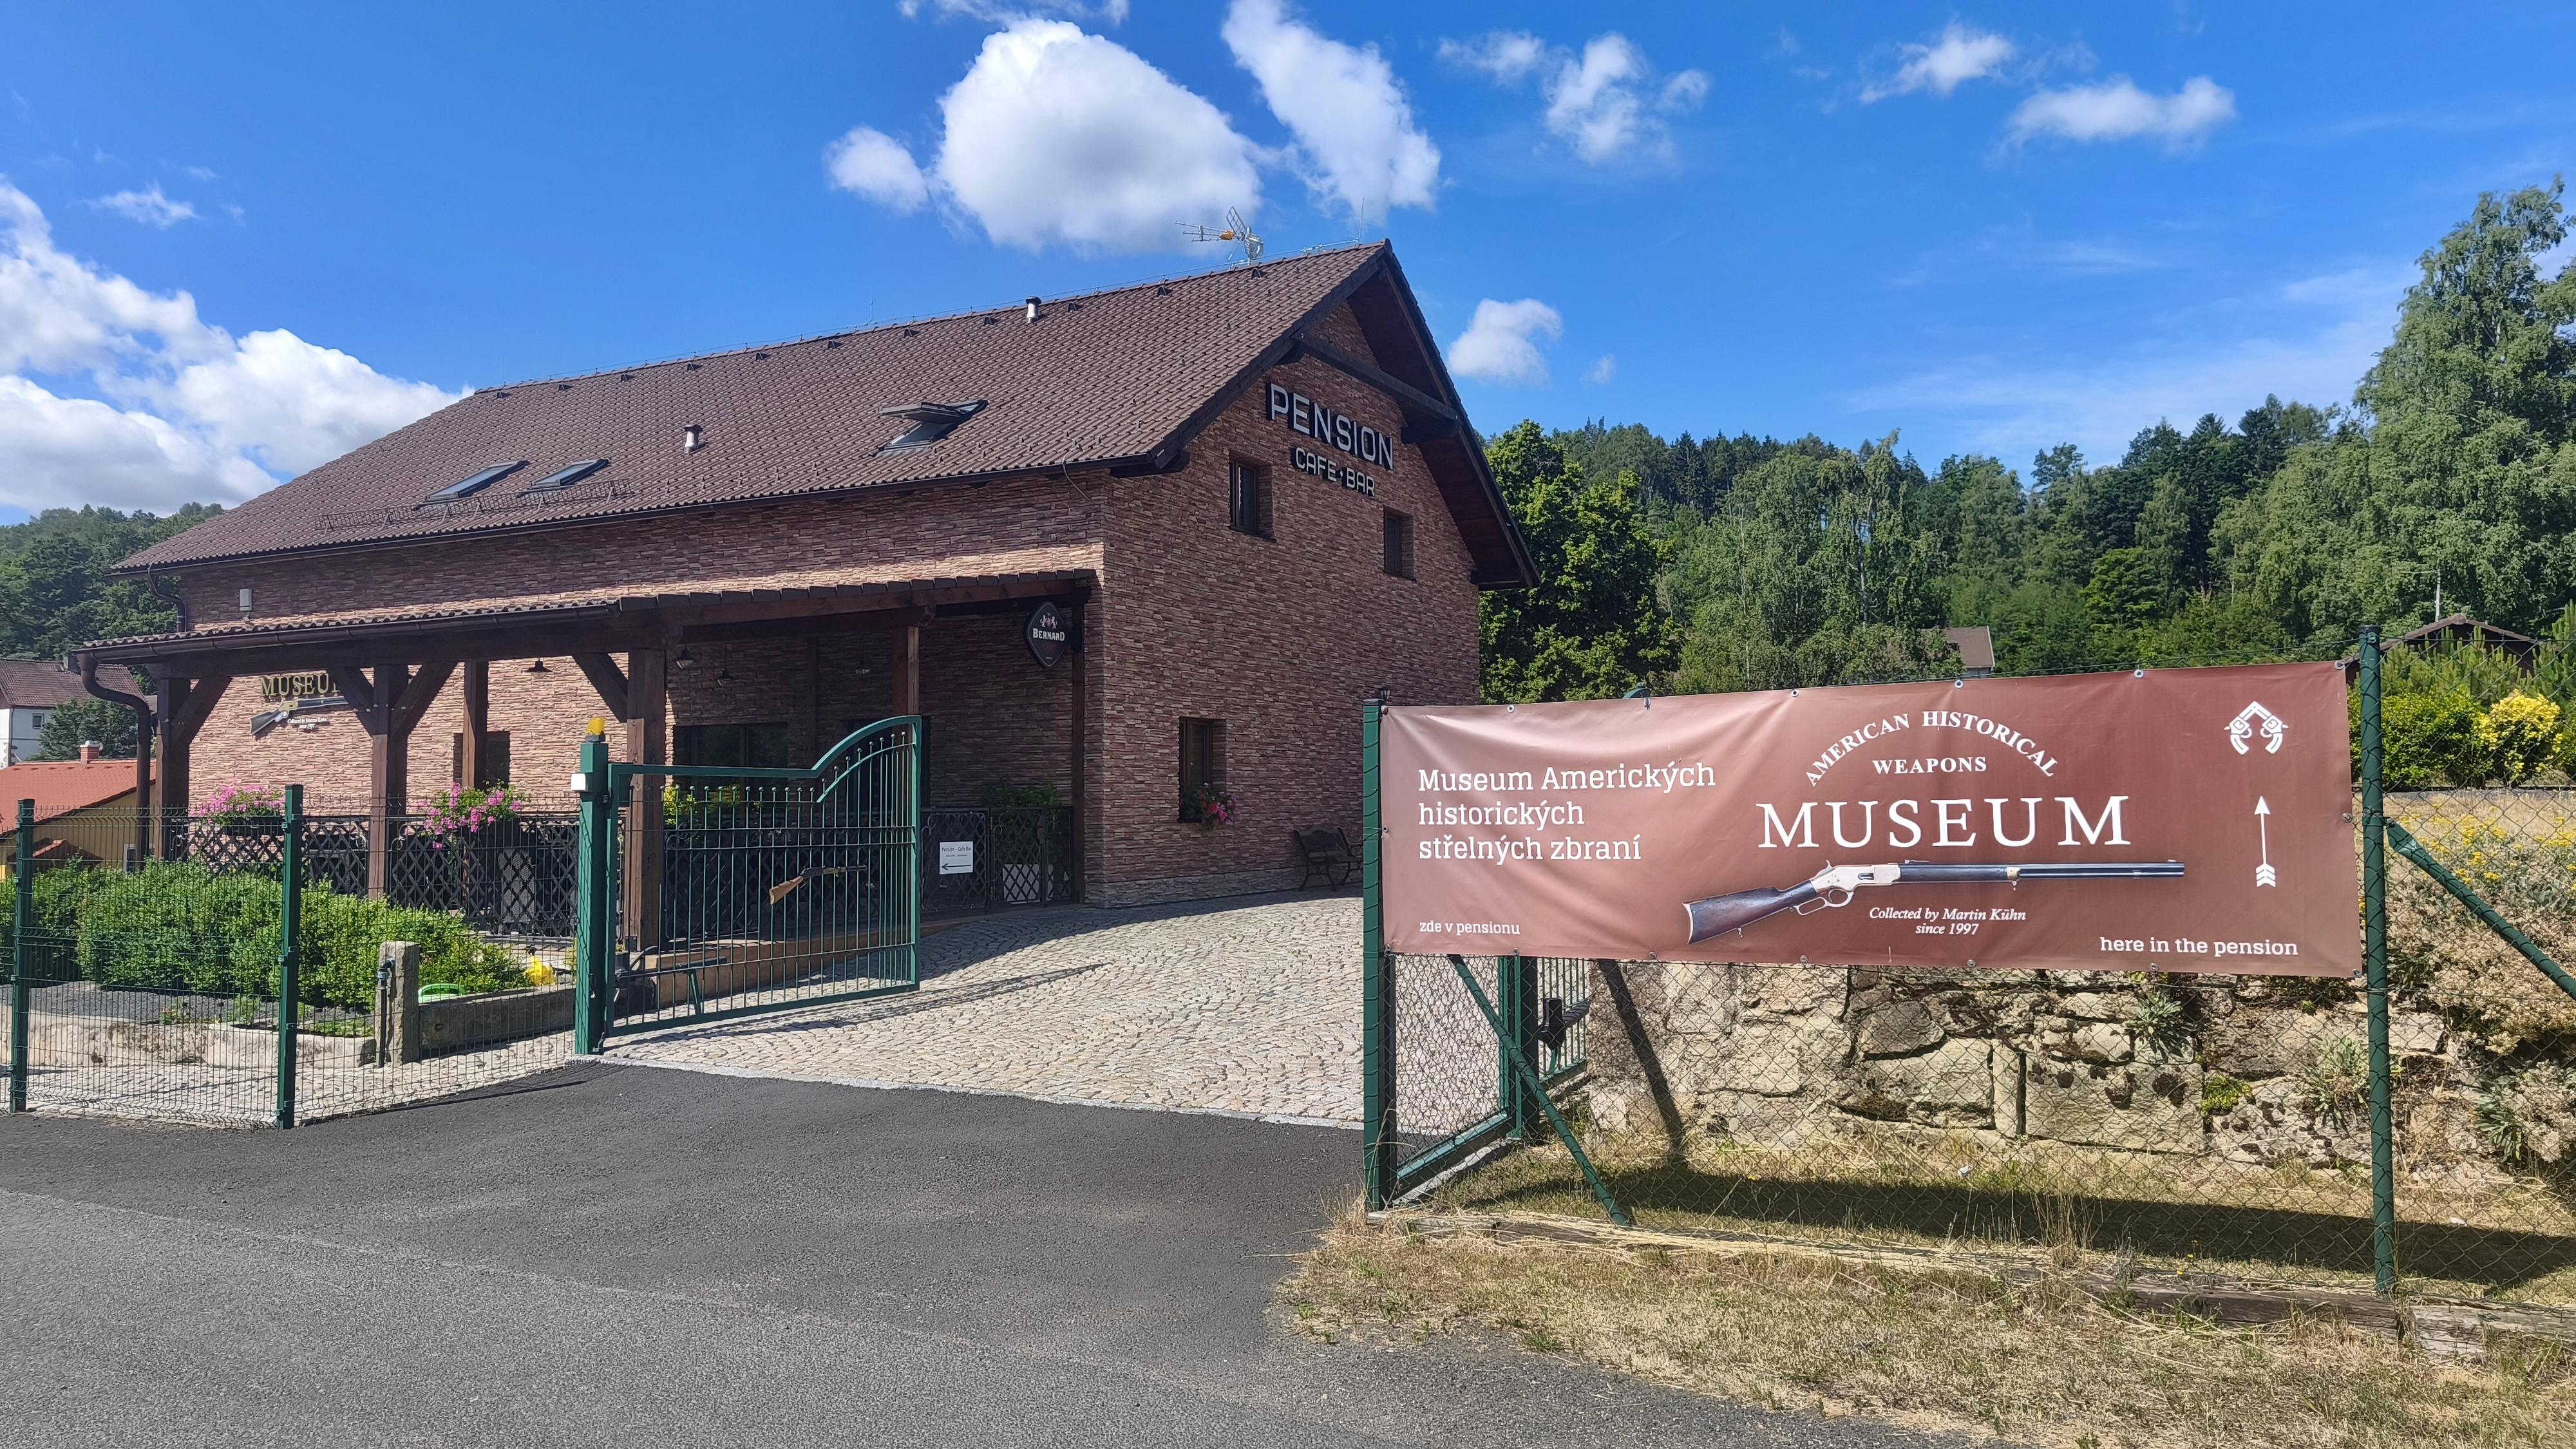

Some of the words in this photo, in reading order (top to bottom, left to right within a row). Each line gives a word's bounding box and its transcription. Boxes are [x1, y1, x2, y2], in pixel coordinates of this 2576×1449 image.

[1269, 383, 1393, 470] PENSION
[1032, 628, 1065, 641] BERNARD
[1806, 713, 1909, 788] AMERICAN
[1921, 710, 2059, 777] HISTORICAL
[1418, 769, 1534, 791] Museum
[1540, 761, 1716, 793] Amerických
[1871, 756, 1987, 775] WEAPONS
[1418, 800, 1585, 831] historických
[1755, 795, 2132, 848] MUSEUM
[1419, 834, 1543, 866] střelných
[1550, 833, 1642, 860] zbraní
[1419, 920, 1442, 933] zde
[1444, 922, 1454, 933] v
[1456, 922, 1520, 936] pensionu
[1869, 907, 1922, 920] Collected
[1924, 907, 1940, 923] by
[1942, 908, 1987, 920] Martin
[1989, 908, 2027, 921] Kühn
[1915, 923, 1946, 934] since
[1948, 923, 1980, 935] 1997
[2099, 936, 2145, 952] here
[2149, 936, 2170, 952] in
[2174, 938, 2208, 954] the
[2213, 939, 2298, 958] pension
